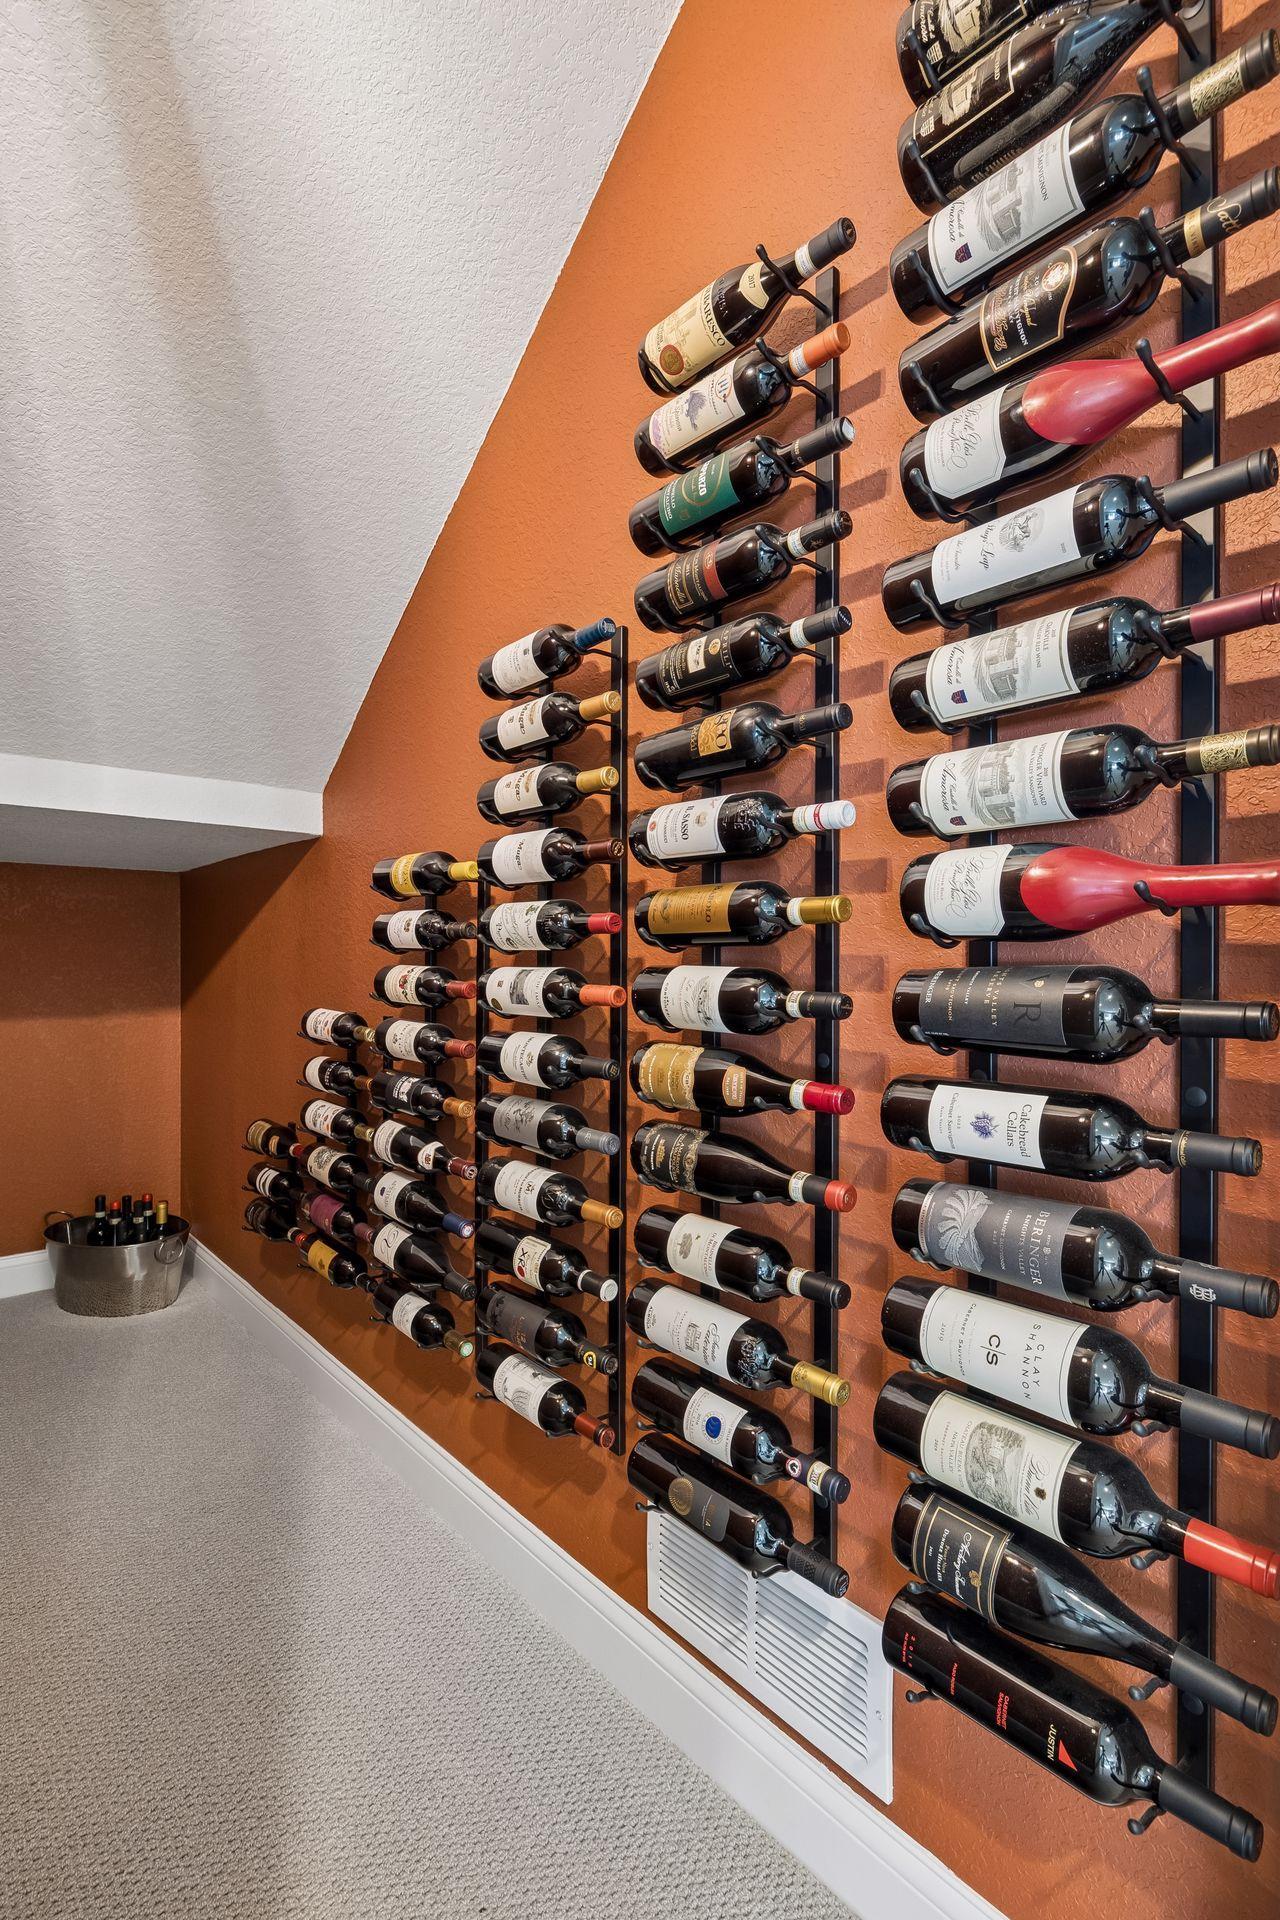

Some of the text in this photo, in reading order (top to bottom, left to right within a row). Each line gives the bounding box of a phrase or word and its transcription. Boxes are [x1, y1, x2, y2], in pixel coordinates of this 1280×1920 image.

[1036, 772, 1048, 806] VINEYARD
[682, 813, 690, 841] SASSO
[991, 989, 1000, 1027] VALLEY
[947, 1092, 959, 1119] Cabernet
[1007, 1111, 1017, 1147] Cellars
[1019, 1104, 1032, 1158] Cakebread
[1000, 1209, 1013, 1237] CABERNET
[1017, 1214, 1033, 1275] KNIGHTS VALLEY
[1029, 1210, 1050, 1285] BERINGER
[960, 1303, 977, 1336] CABERNET
[957, 1338, 965, 1376] SAUVIGNON
[1021, 1323, 1041, 1400] SHANNON
[1033, 1343, 1045, 1387] CLAY
[996, 1692, 1004, 1726] SAUVIGNON
[1001, 1695, 1009, 1730] CABERNET
[1047, 1724, 1057, 1761] JUSTIN
